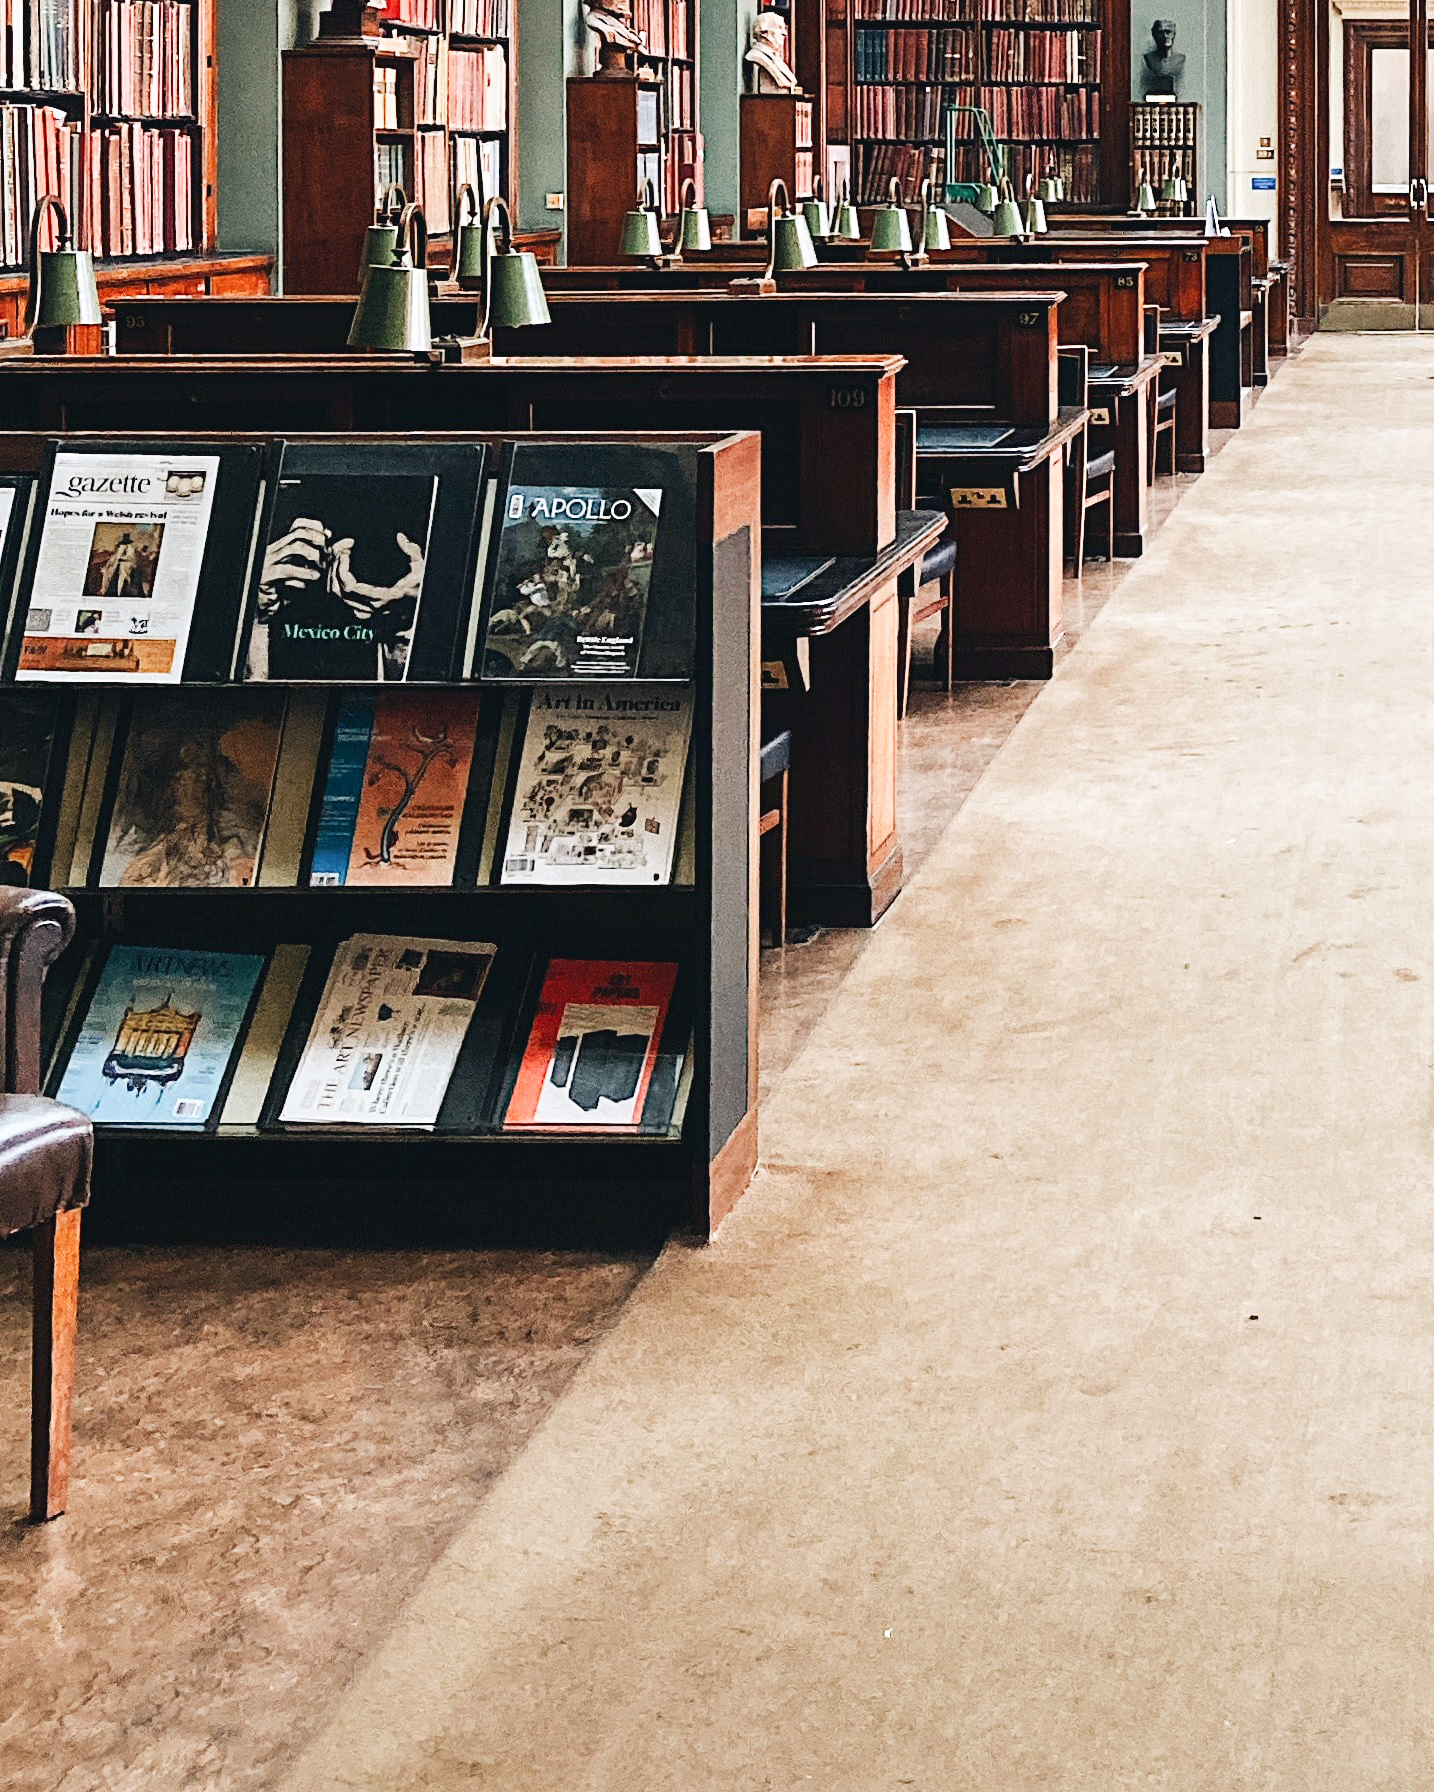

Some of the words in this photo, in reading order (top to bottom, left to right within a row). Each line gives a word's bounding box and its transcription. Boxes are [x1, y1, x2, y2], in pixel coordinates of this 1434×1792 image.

[1117, 276, 1134, 287] 85
[1019, 312, 1040, 325] 97
[830, 389, 865, 407] 109
[55, 474, 151, 498] gazette
[531, 498, 632, 520] APOLLO
[283, 624, 340, 640] Mexico
[344, 625, 375, 644] City
[536, 692, 571, 709] Art
[576, 693, 595, 710] in
[604, 693, 682, 712] America
[317, 1077, 339, 1108] THE
[333, 1044, 354, 1074] ART
